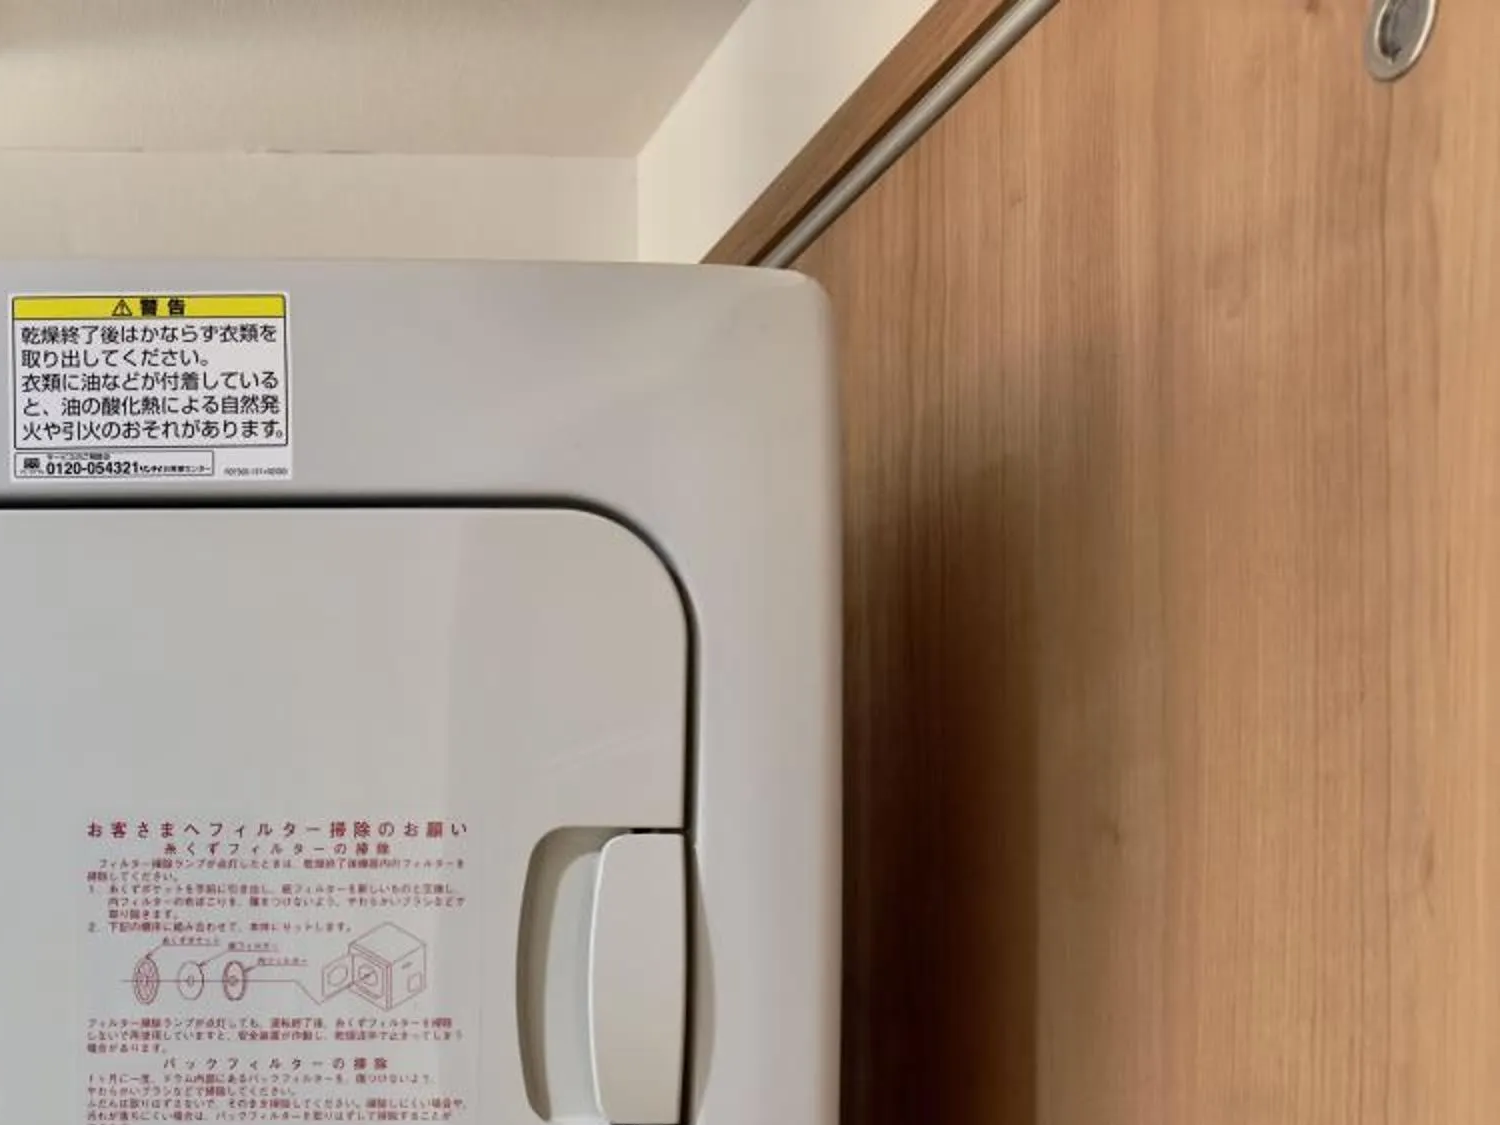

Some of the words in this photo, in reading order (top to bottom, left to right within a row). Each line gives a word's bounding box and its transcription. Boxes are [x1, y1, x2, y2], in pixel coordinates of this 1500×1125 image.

[139, 298, 186, 316] 警告
[21, 323, 277, 345] 乾燥終了後はかならず衣類を
[21, 349, 209, 369] 取り出してください。
[21, 371, 279, 393] 衣類に油などが付着している
[23, 395, 280, 417] と、油の酸化熱による自然発
[23, 420, 283, 441] 火や引火のおそれがあります。
[45, 461, 138, 475] 0120-054321
[87, 821, 467, 838] お客さまへフィルター掃除のお願い
[163, 842, 390, 856] 糸くずフィルターの掃除
[163, 1056, 388, 1070] バックフィルターの掃除
